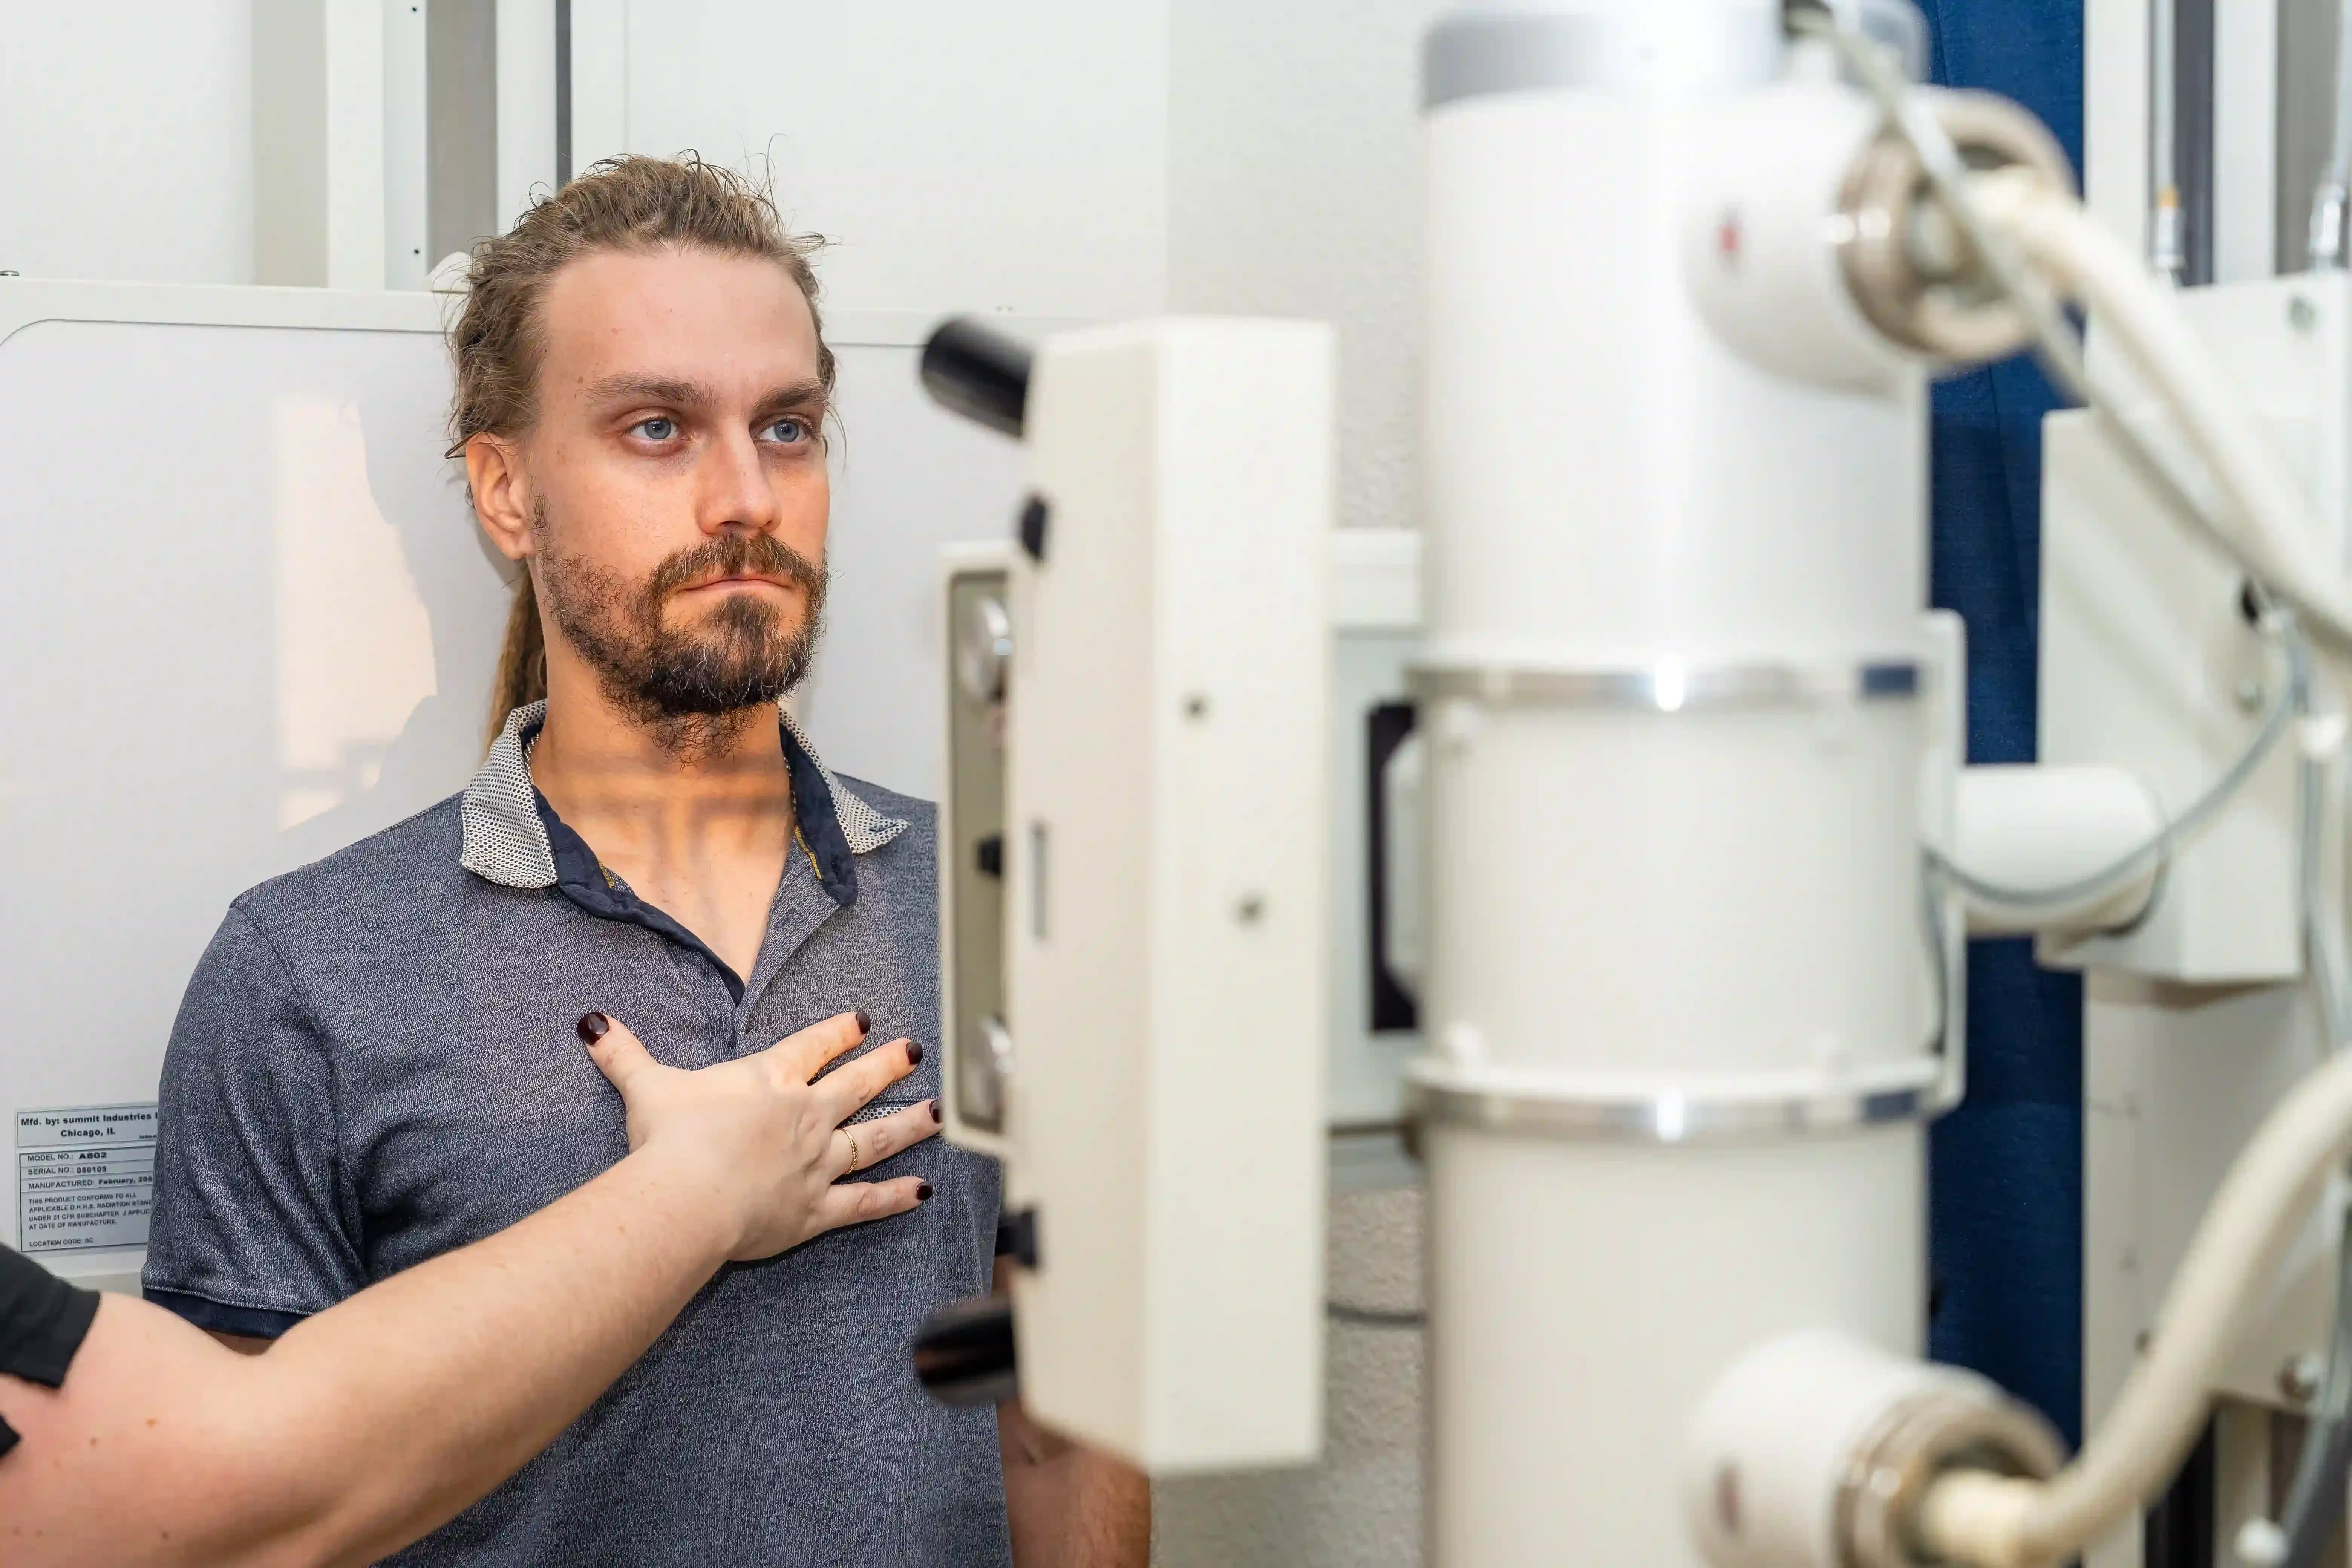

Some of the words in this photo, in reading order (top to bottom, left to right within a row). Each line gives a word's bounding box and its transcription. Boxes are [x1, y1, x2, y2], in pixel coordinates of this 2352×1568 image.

[45, 1117, 60, 1126] by:
[63, 1115, 100, 1124] summit
[103, 1112, 152, 1122] Industries
[61, 1128, 103, 1137] Chicago,
[44, 1196, 75, 1204] PRODUCT
[29, 1204, 69, 1213] APPLICABLE
[77, 1210, 119, 1219] SUBCHAPTER
[29, 1239, 61, 1247] LOCATION
